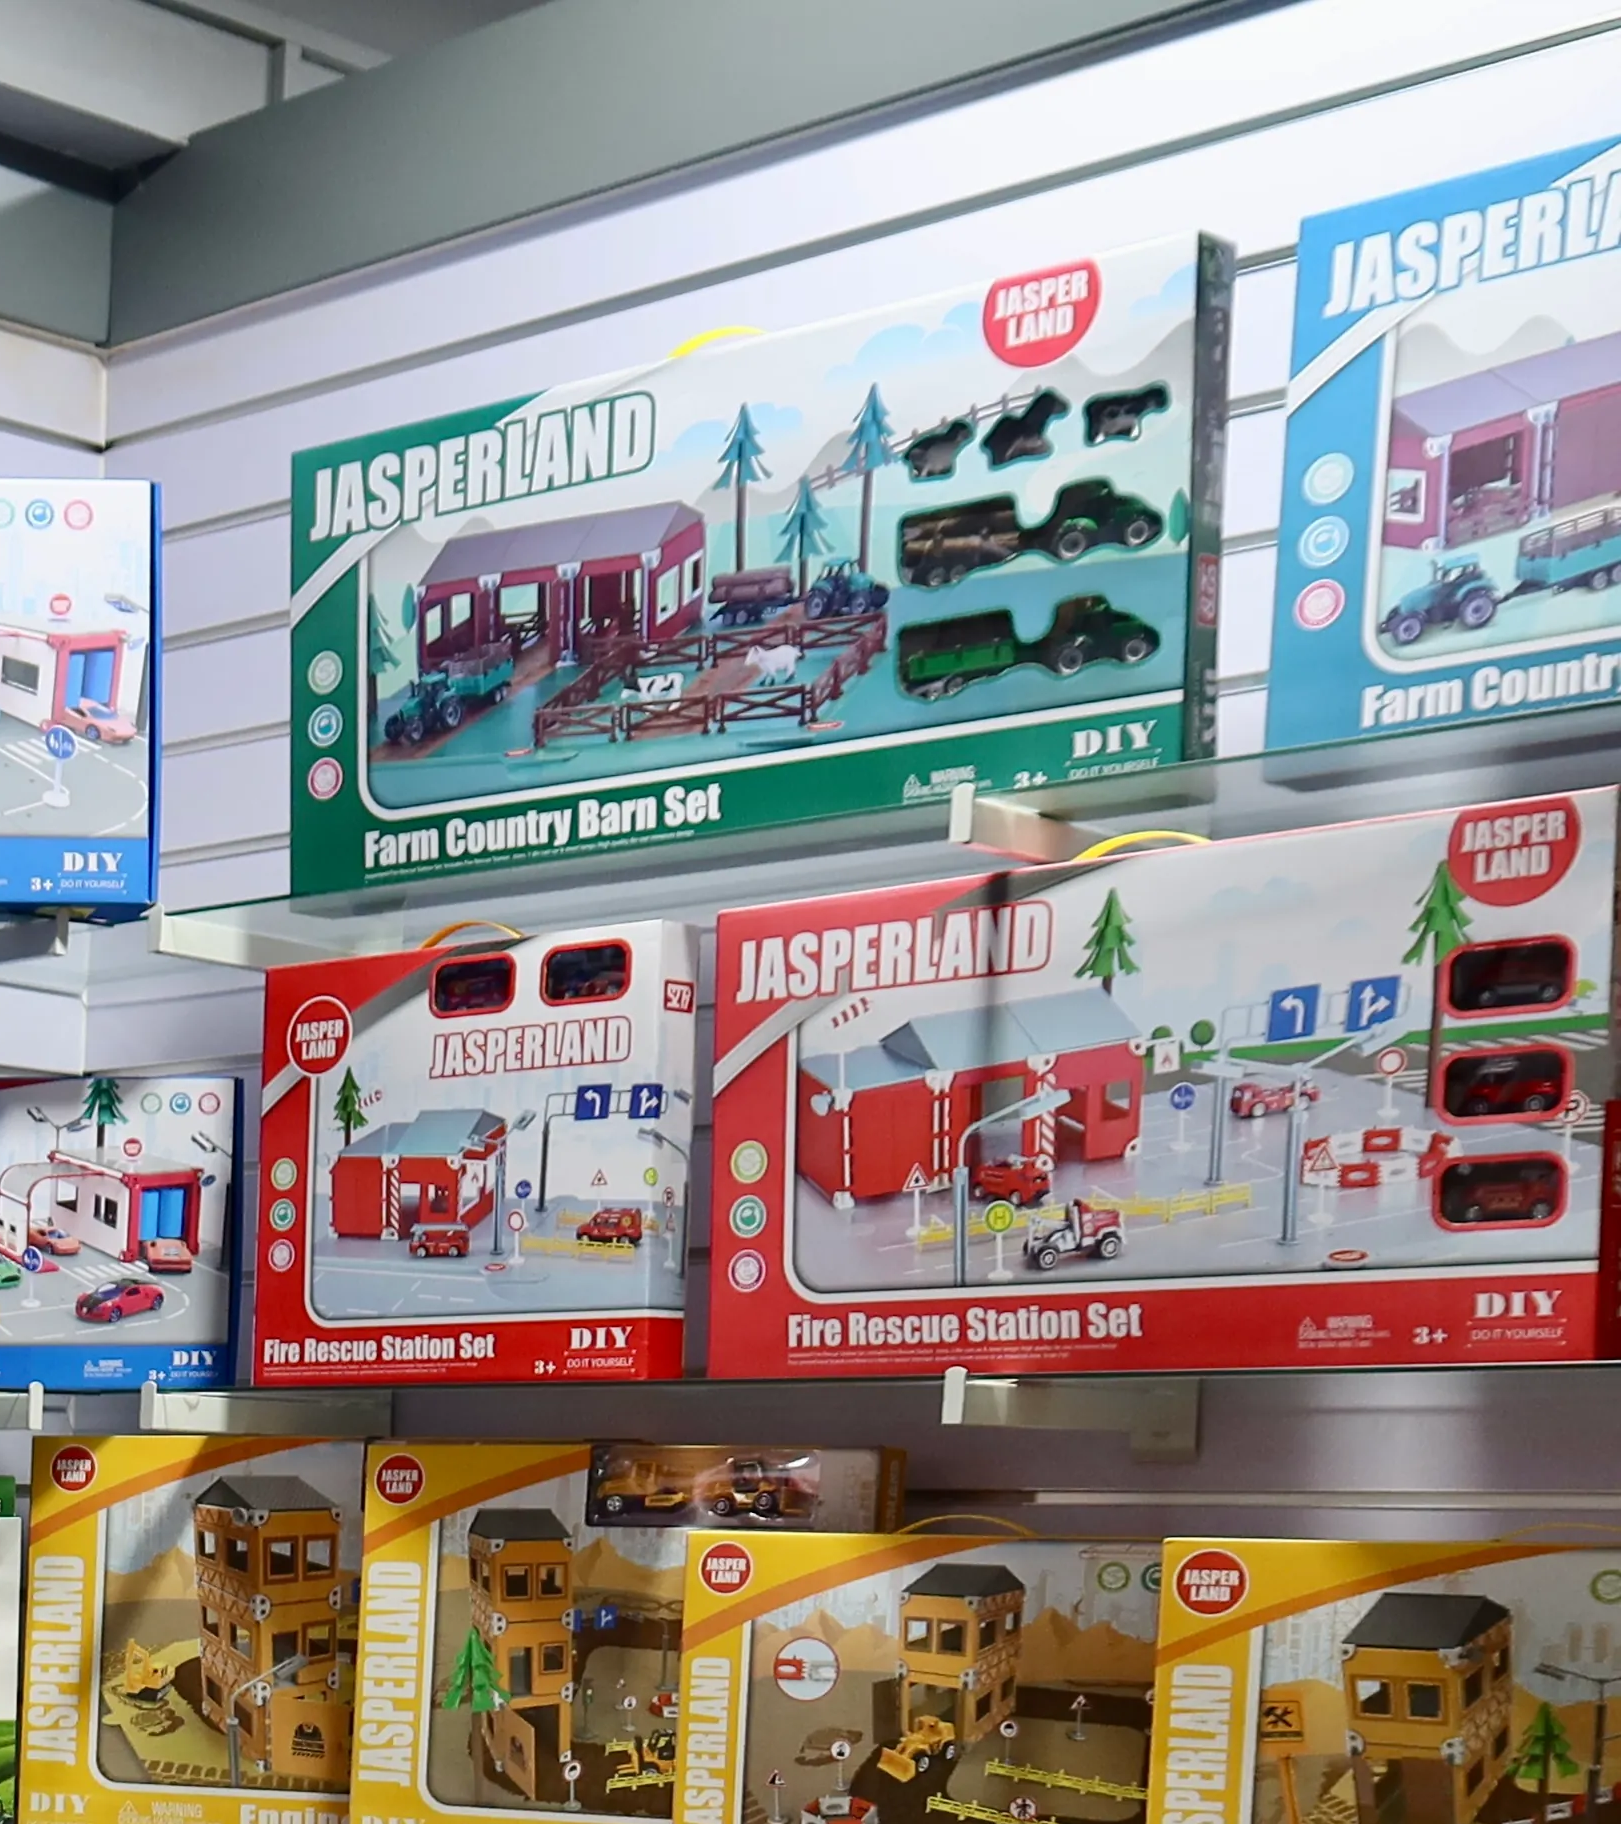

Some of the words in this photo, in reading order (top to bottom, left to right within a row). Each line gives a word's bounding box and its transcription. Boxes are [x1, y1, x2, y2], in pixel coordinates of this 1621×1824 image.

[993, 273, 1088, 323] JASPER
[1007, 308, 1074, 350] LAND
[309, 394, 654, 543] JASPERLAND
[1360, 678, 1463, 730] Farm
[1470, 650, 1621, 712] Countr
[364, 826, 439, 869] Farm
[446, 808, 572, 859] Country
[578, 796, 658, 842] Barn
[663, 782, 722, 831] Set
[1461, 811, 1567, 856] JASPER
[62, 851, 124, 874] DIY
[1475, 842, 1551, 884] LAND
[736, 901, 1053, 1004] JASPERLAND
[295, 1022, 345, 1042] JASPER
[301, 1040, 337, 1061] LAND
[429, 1016, 632, 1078] JASPERLAND
[788, 1313, 846, 1349] Fire
[853, 1308, 961, 1348] Rescue
[965, 1304, 1080, 1343] Station
[1087, 1302, 1143, 1339] Set
[263, 1339, 301, 1363] Fire
[304, 1337, 378, 1363] Rescue
[382, 1335, 458, 1361] Station
[459, 1333, 496, 1359] Set
[569, 1326, 634, 1350] DIY
[56, 1459, 92, 1473] JASPER
[60, 1470, 88, 1484] LAND
[381, 1470, 420, 1484] JASPER
[385, 1480, 414, 1495] LAND
[706, 1556, 747, 1573] JASPER
[711, 1571, 741, 1585] LAND
[1183, 1569, 1240, 1588] JASPER
[1189, 1585, 1231, 1603] LAND
[27, 1555, 86, 1767] JASPERLAND
[358, 1560, 423, 1789] JASPERLAND
[29, 1791, 91, 1815] DIY
[150, 1801, 204, 1819] WARNING
